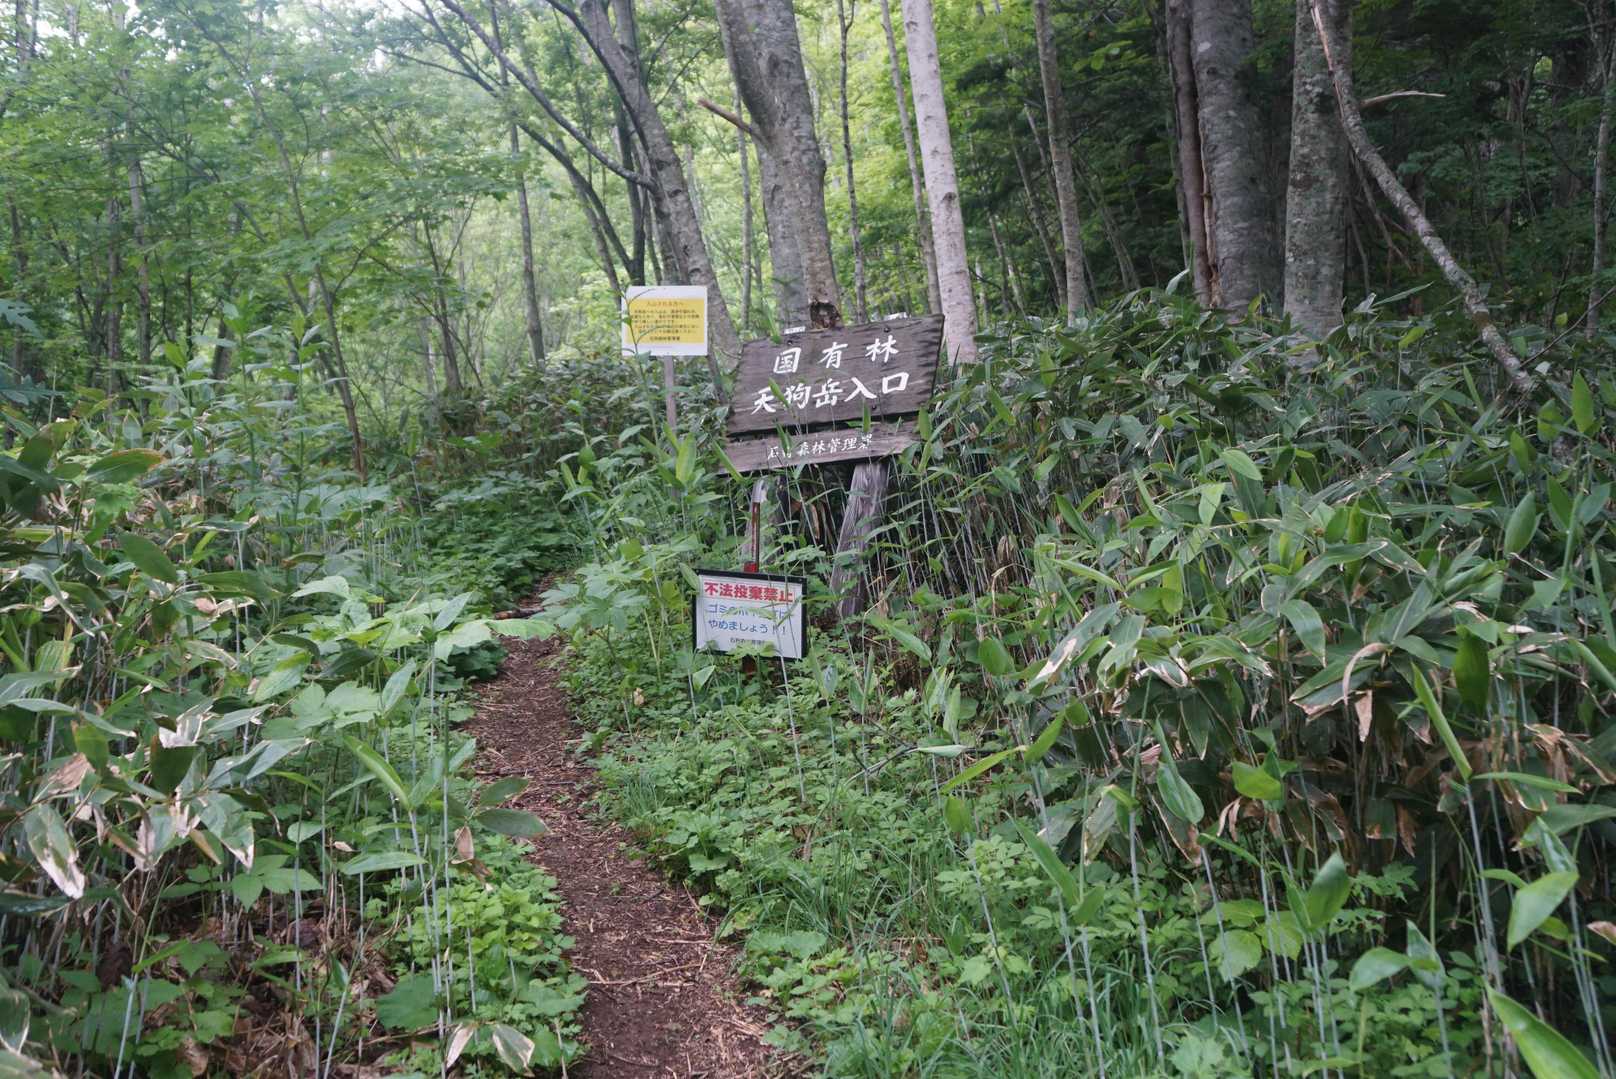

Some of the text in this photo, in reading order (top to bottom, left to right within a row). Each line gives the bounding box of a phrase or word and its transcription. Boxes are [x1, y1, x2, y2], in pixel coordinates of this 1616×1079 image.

[773, 335, 899, 374] 国有林
[751, 371, 910, 414] 天狗岳入口
[704, 582, 794, 602] 不法投棄禁止
